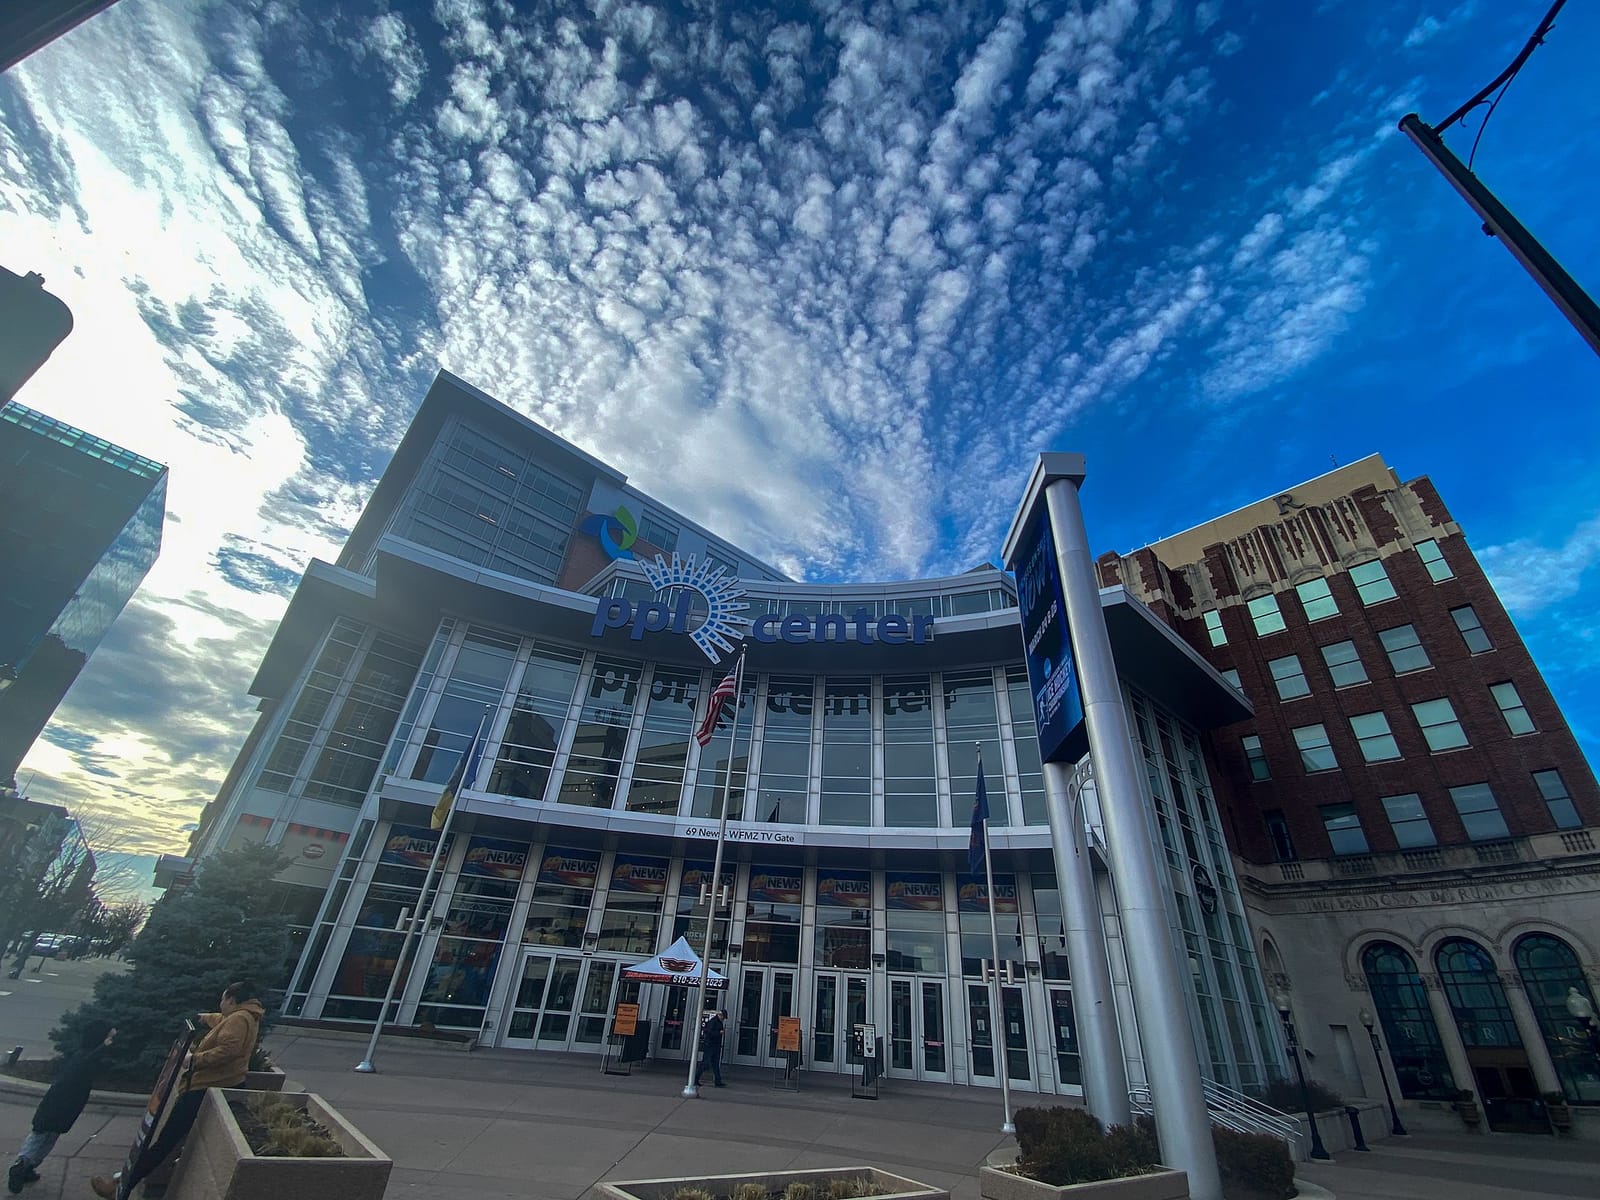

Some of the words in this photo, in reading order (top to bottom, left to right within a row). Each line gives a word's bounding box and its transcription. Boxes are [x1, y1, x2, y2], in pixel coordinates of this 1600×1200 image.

[1272, 493, 1305, 516] R
[591, 592, 691, 641] ppl
[752, 608, 934, 645] center
[686, 827, 697, 836] 69
[729, 830, 759, 840] WFMZ
[761, 832, 772, 841] TV
[774, 833, 795, 842] Gate
[485, 850, 524, 865] NEWS
[560, 859, 596, 873] NEWS
[632, 866, 666, 880] NEWS
[767, 877, 800, 889] NEWS
[835, 881, 869, 893] NEWS
[905, 884, 939, 895] NEWS
[977, 885, 1014, 898] NWS
[672, 975, 723, 987] 610-22625
[1482, 1026, 1495, 1040] R
[1566, 1025, 1578, 1038] R
